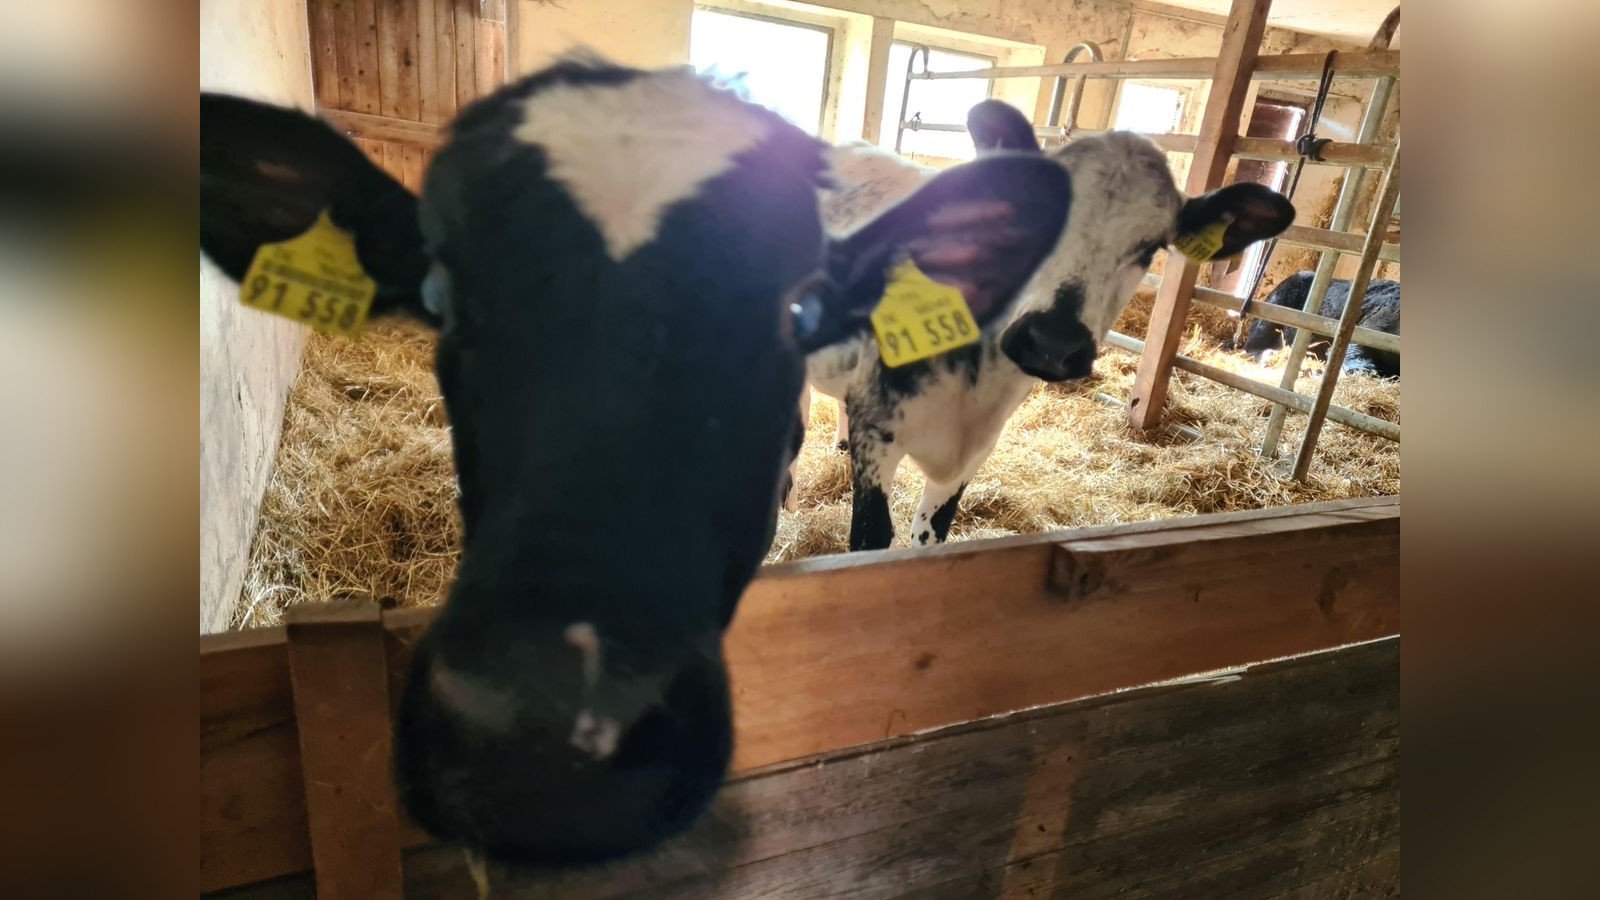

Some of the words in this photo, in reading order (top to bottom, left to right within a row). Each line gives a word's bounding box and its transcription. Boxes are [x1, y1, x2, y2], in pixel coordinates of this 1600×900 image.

[249, 273, 289, 309] 91
[297, 289, 361, 330] 558
[885, 326, 919, 358] 91
[922, 309, 972, 347] 558
